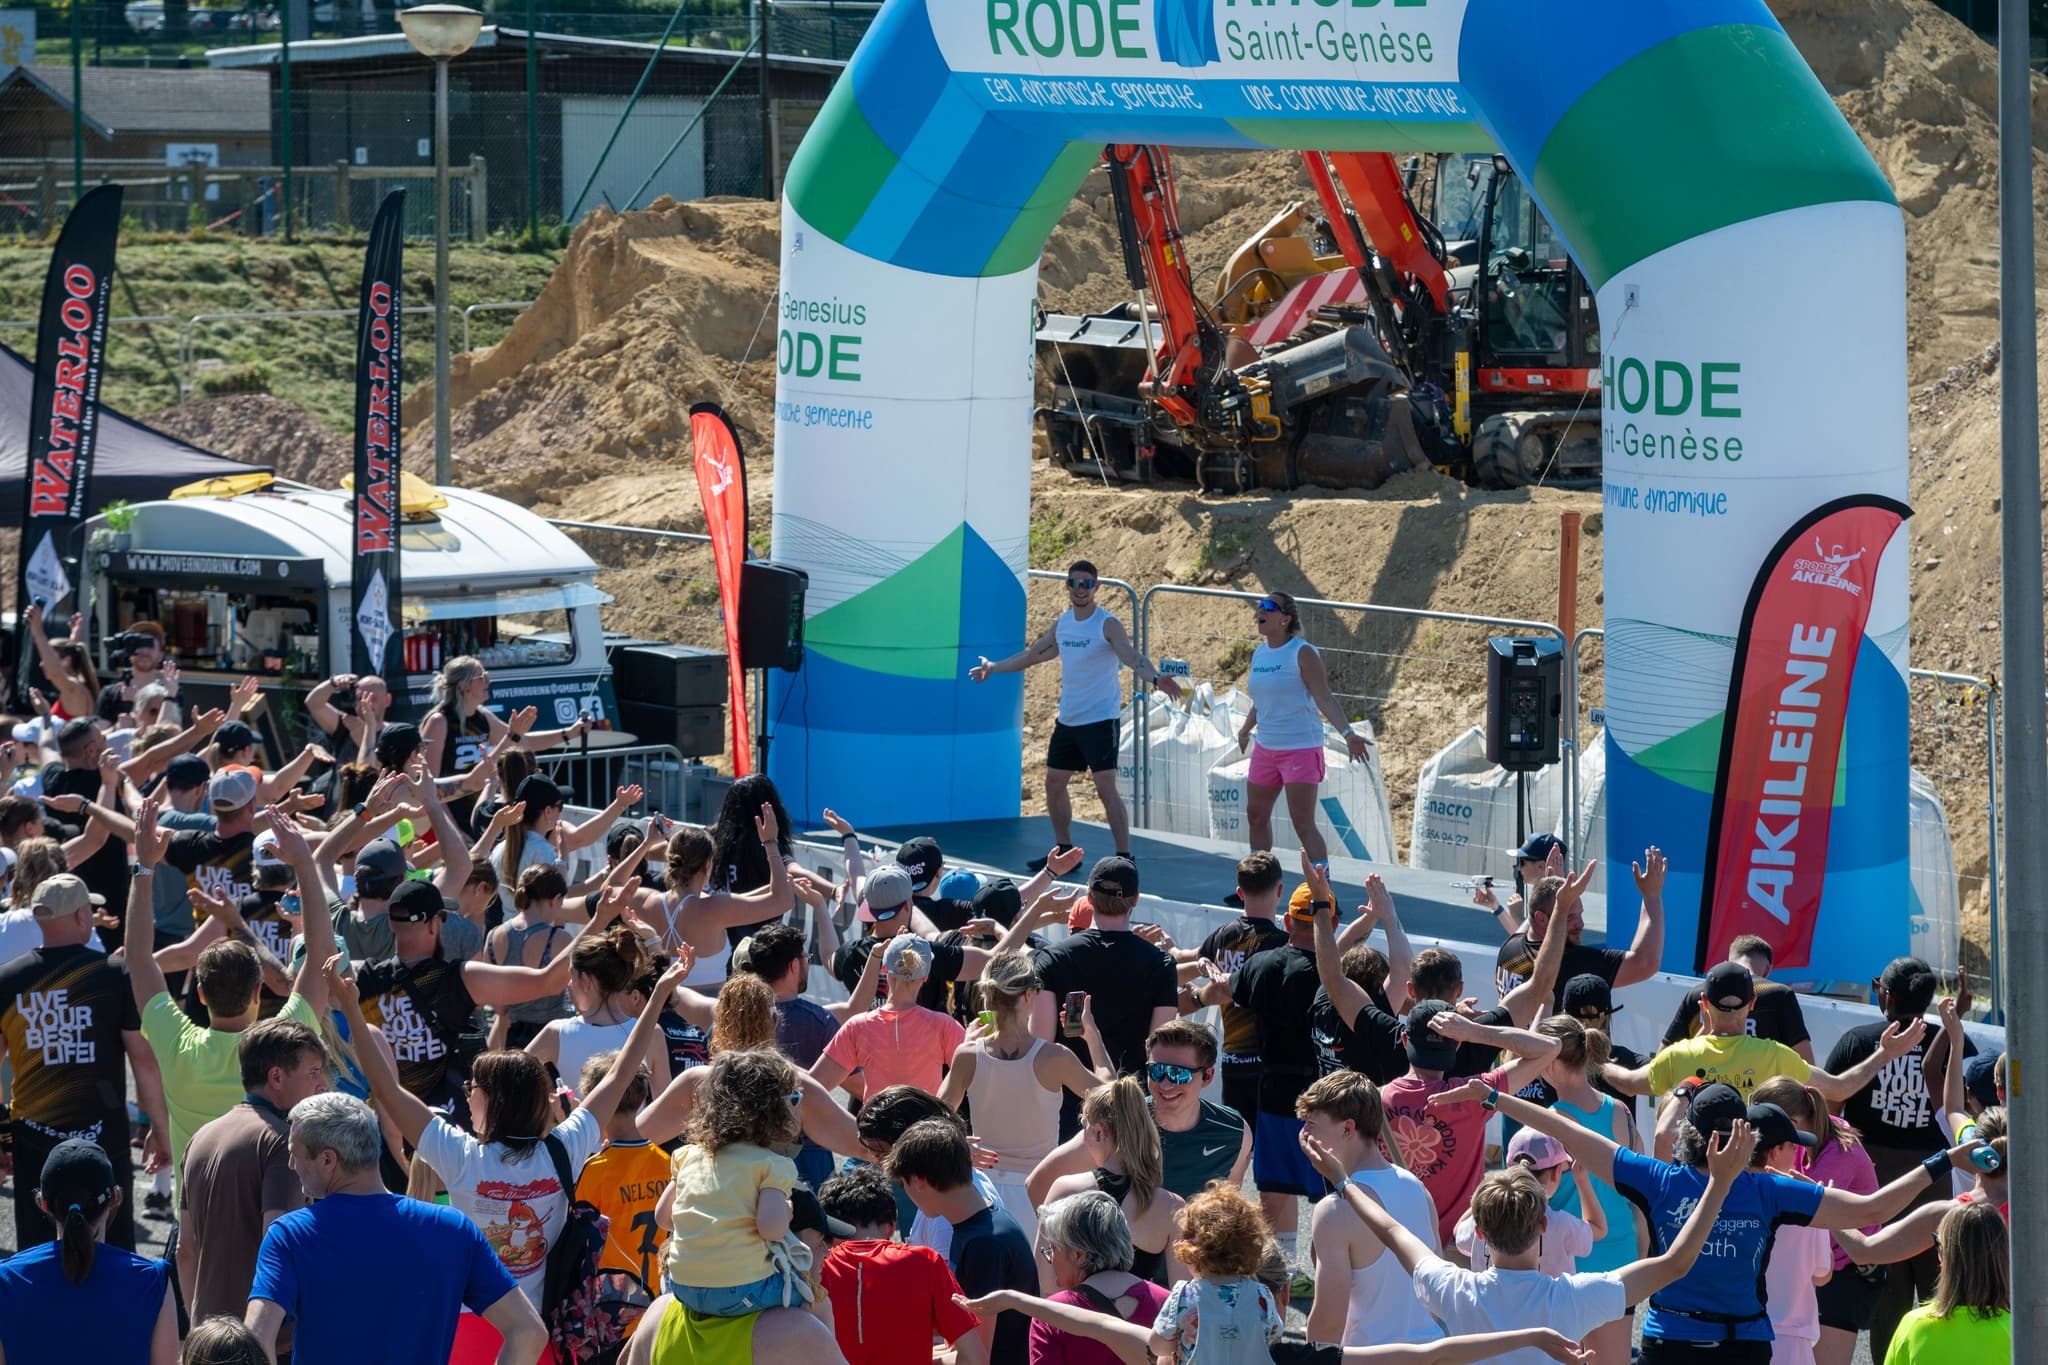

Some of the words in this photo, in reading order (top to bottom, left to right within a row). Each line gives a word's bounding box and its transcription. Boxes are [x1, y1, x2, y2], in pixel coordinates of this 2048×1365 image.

[987, 0, 1148, 58] RODE
[1226, 19, 1433, 63] Saint-Genèse
[984, 77, 1022, 103] Een
[1021, 77, 1114, 107] dynamische
[1112, 81, 1203, 110] gemeente
[1241, 84, 1282, 110] une
[1280, 84, 1375, 113] commune
[1372, 86, 1466, 116] dynamique
[30, 264, 95, 517] WATERLOO
[1602, 354, 1741, 418] HODE
[357, 281, 391, 556] WATERLOO
[804, 403, 872, 430] gemeente
[1644, 487, 1727, 517] dynamique
[1793, 558, 1838, 575] SPORTS
[1160, 661, 1188, 675] Leviat
[1747, 623, 1837, 926] AKILEÏNE
[195, 864, 233, 884] LIVE
[16, 989, 69, 1015] LIVE
[21, 1006, 93, 1032] YOUR
[25, 1025, 87, 1050] BEST
[43, 1042, 96, 1066] LIFE!
[1871, 1089, 1930, 1112] BEST
[1415, 1108, 1456, 1158] NOBODY
[1881, 1109, 1931, 1129] LIFE
